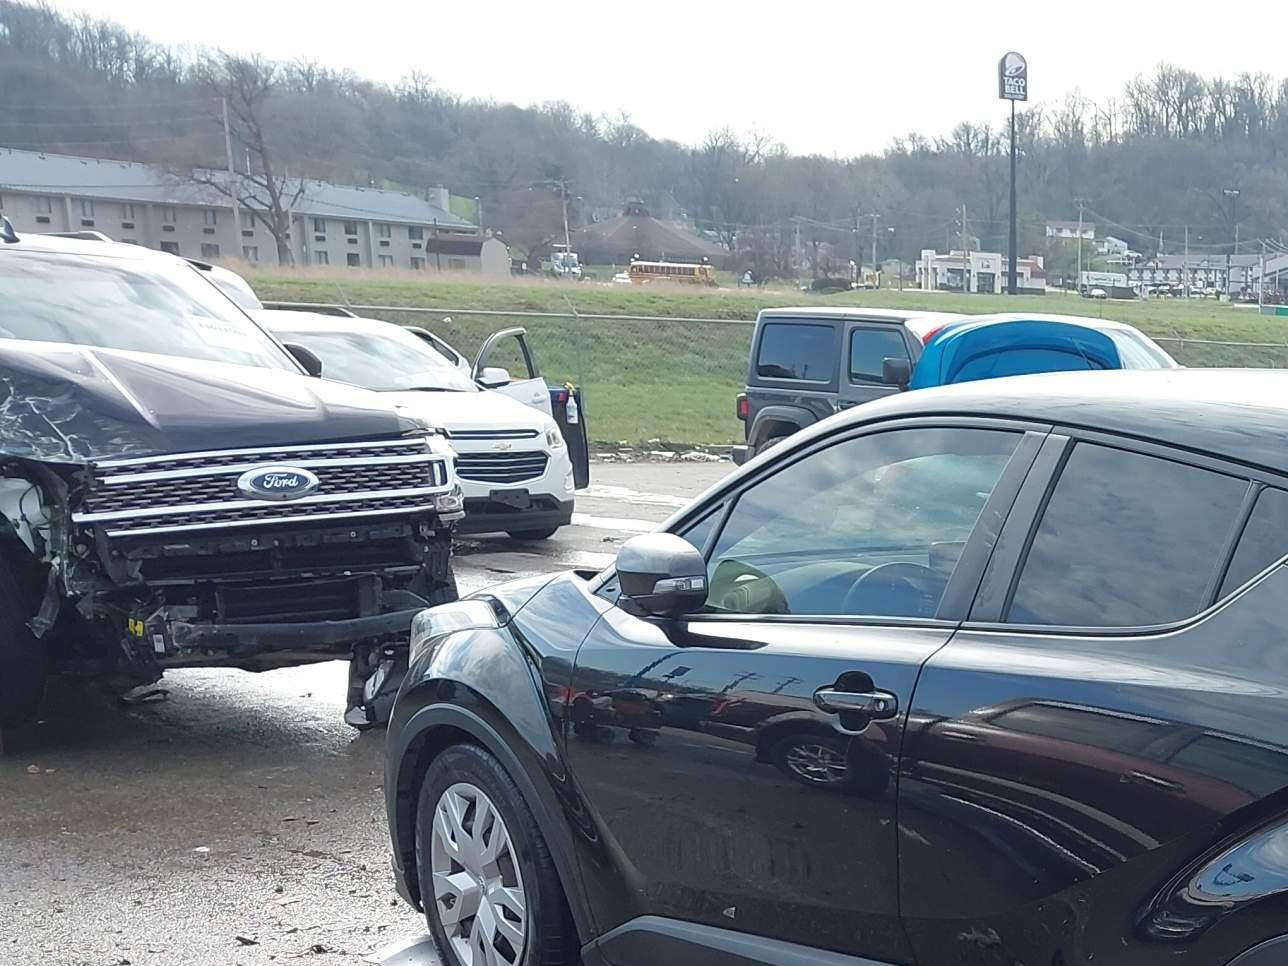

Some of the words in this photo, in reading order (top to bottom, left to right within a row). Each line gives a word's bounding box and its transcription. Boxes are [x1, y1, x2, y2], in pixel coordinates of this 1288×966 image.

[1003, 77, 1026, 87] TACO
[1005, 85, 1026, 94] BELL
[263, 473, 299, 489] Ford
